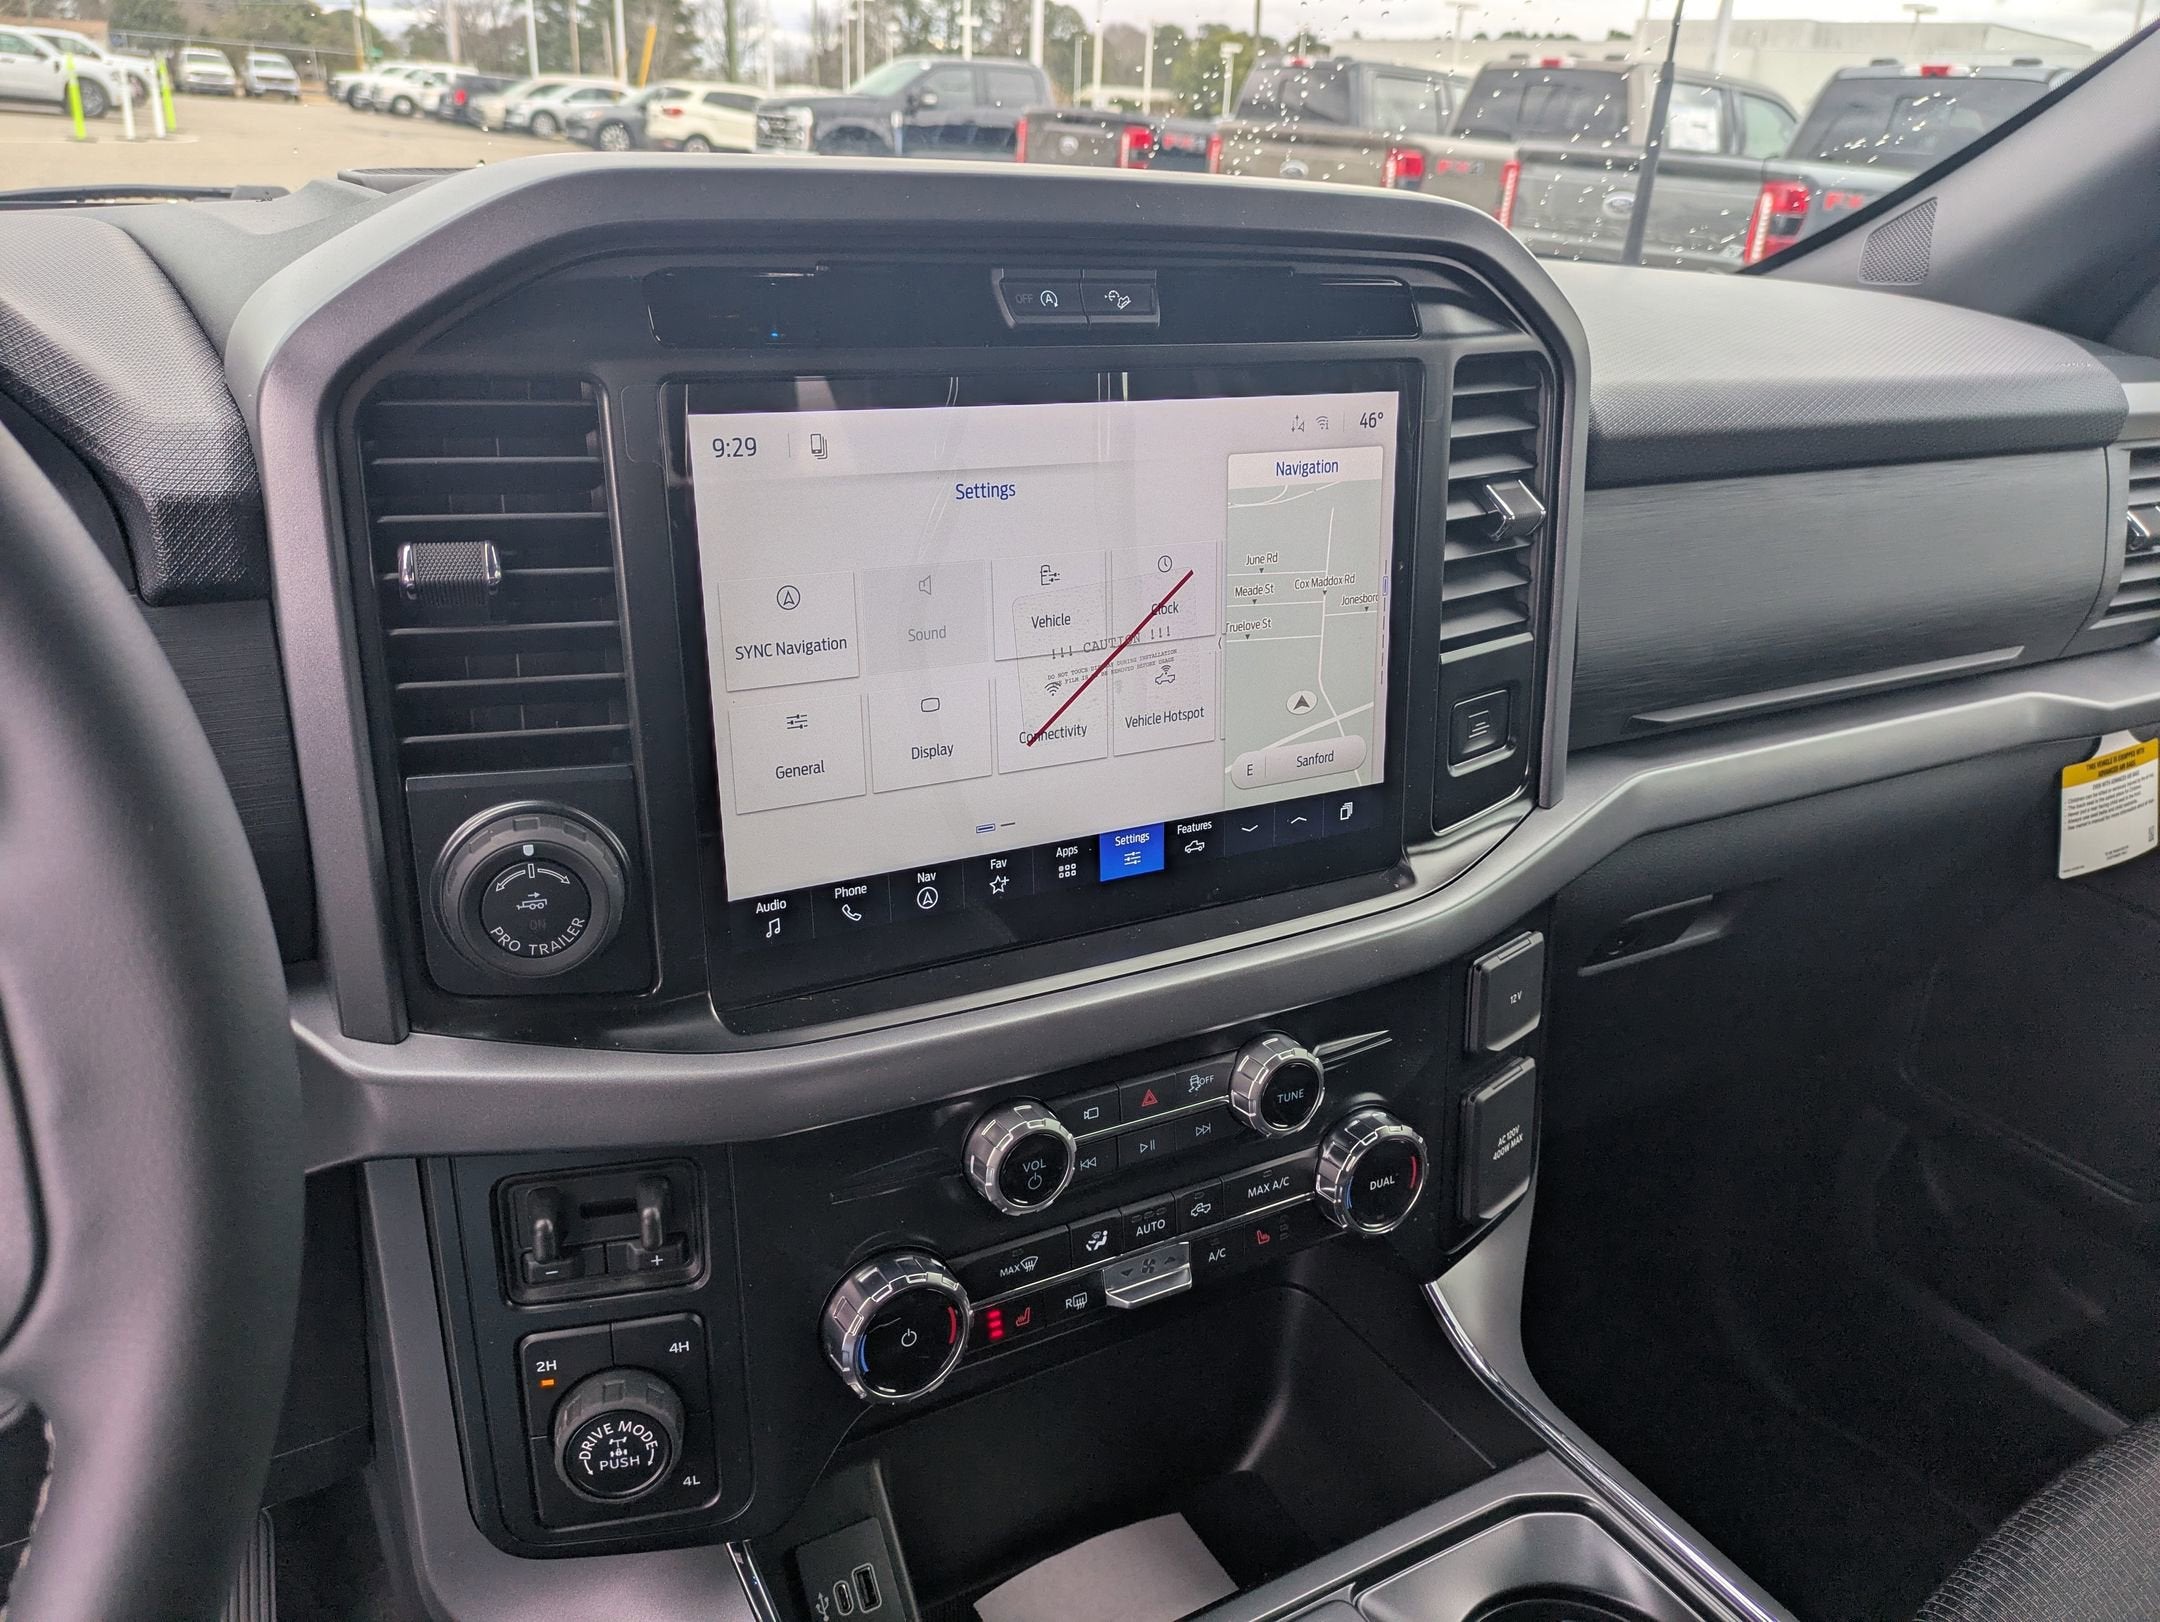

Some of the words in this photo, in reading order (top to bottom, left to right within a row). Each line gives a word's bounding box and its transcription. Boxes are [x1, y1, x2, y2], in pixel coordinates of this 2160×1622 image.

[1359, 412, 1384, 429] 46°
[712, 437, 757, 458] 9:29
[1275, 460, 1339, 477] Navigation
[955, 482, 1016, 501] Settings
[1246, 555, 1265, 565] June
[1266, 552, 1278, 563] Rd
[1294, 578, 1309, 590] Cox
[1311, 576, 1342, 588] Maddox
[1344, 573, 1355, 584] Rd
[1235, 585, 1263, 597] Meade
[1264, 583, 1274, 594] St
[1031, 613, 1071, 629] Vehicle
[1262, 618, 1271, 629] St
[908, 625, 947, 642] Sound
[735, 643, 773, 661] SYNC
[776, 637, 848, 658] Navigation
[1125, 713, 1162, 729] Vehicle
[1163, 707, 1205, 724] Hotspot
[911, 743, 954, 760] Display
[775, 760, 825, 779] General
[1247, 764, 1254, 776] E
[1296, 750, 1335, 769] Sanford
[1176, 820, 1212, 835] Features
[1114, 831, 1150, 847] Settings
[1055, 844, 1078, 859] Apps
[990, 858, 1007, 869] Fav
[917, 871, 936, 883] Nav
[834, 884, 867, 899] Phone
[755, 899, 787, 914] Audio
[490, 926, 521, 952] PRO
[528, 916, 585, 956] TRAILER
[1199, 1074, 1215, 1086] OFF
[1277, 1088, 1305, 1104] TUNE
[1022, 1159, 1047, 1174] VOL
[1247, 1183, 1271, 1199] MAX
[1272, 1176, 1291, 1193] A/C
[1369, 1176, 1396, 1191] DUAL
[1135, 1219, 1167, 1237] AUTO
[1208, 1248, 1226, 1263] A/C
[1000, 1264, 1021, 1278] MAX
[669, 1341, 690, 1354] 4H
[535, 1360, 557, 1373] 2H
[579, 1422, 614, 1460] DRIVE
[618, 1420, 659, 1451] MODE
[600, 1455, 640, 1471] PUSH
[683, 1475, 701, 1487] 4L
